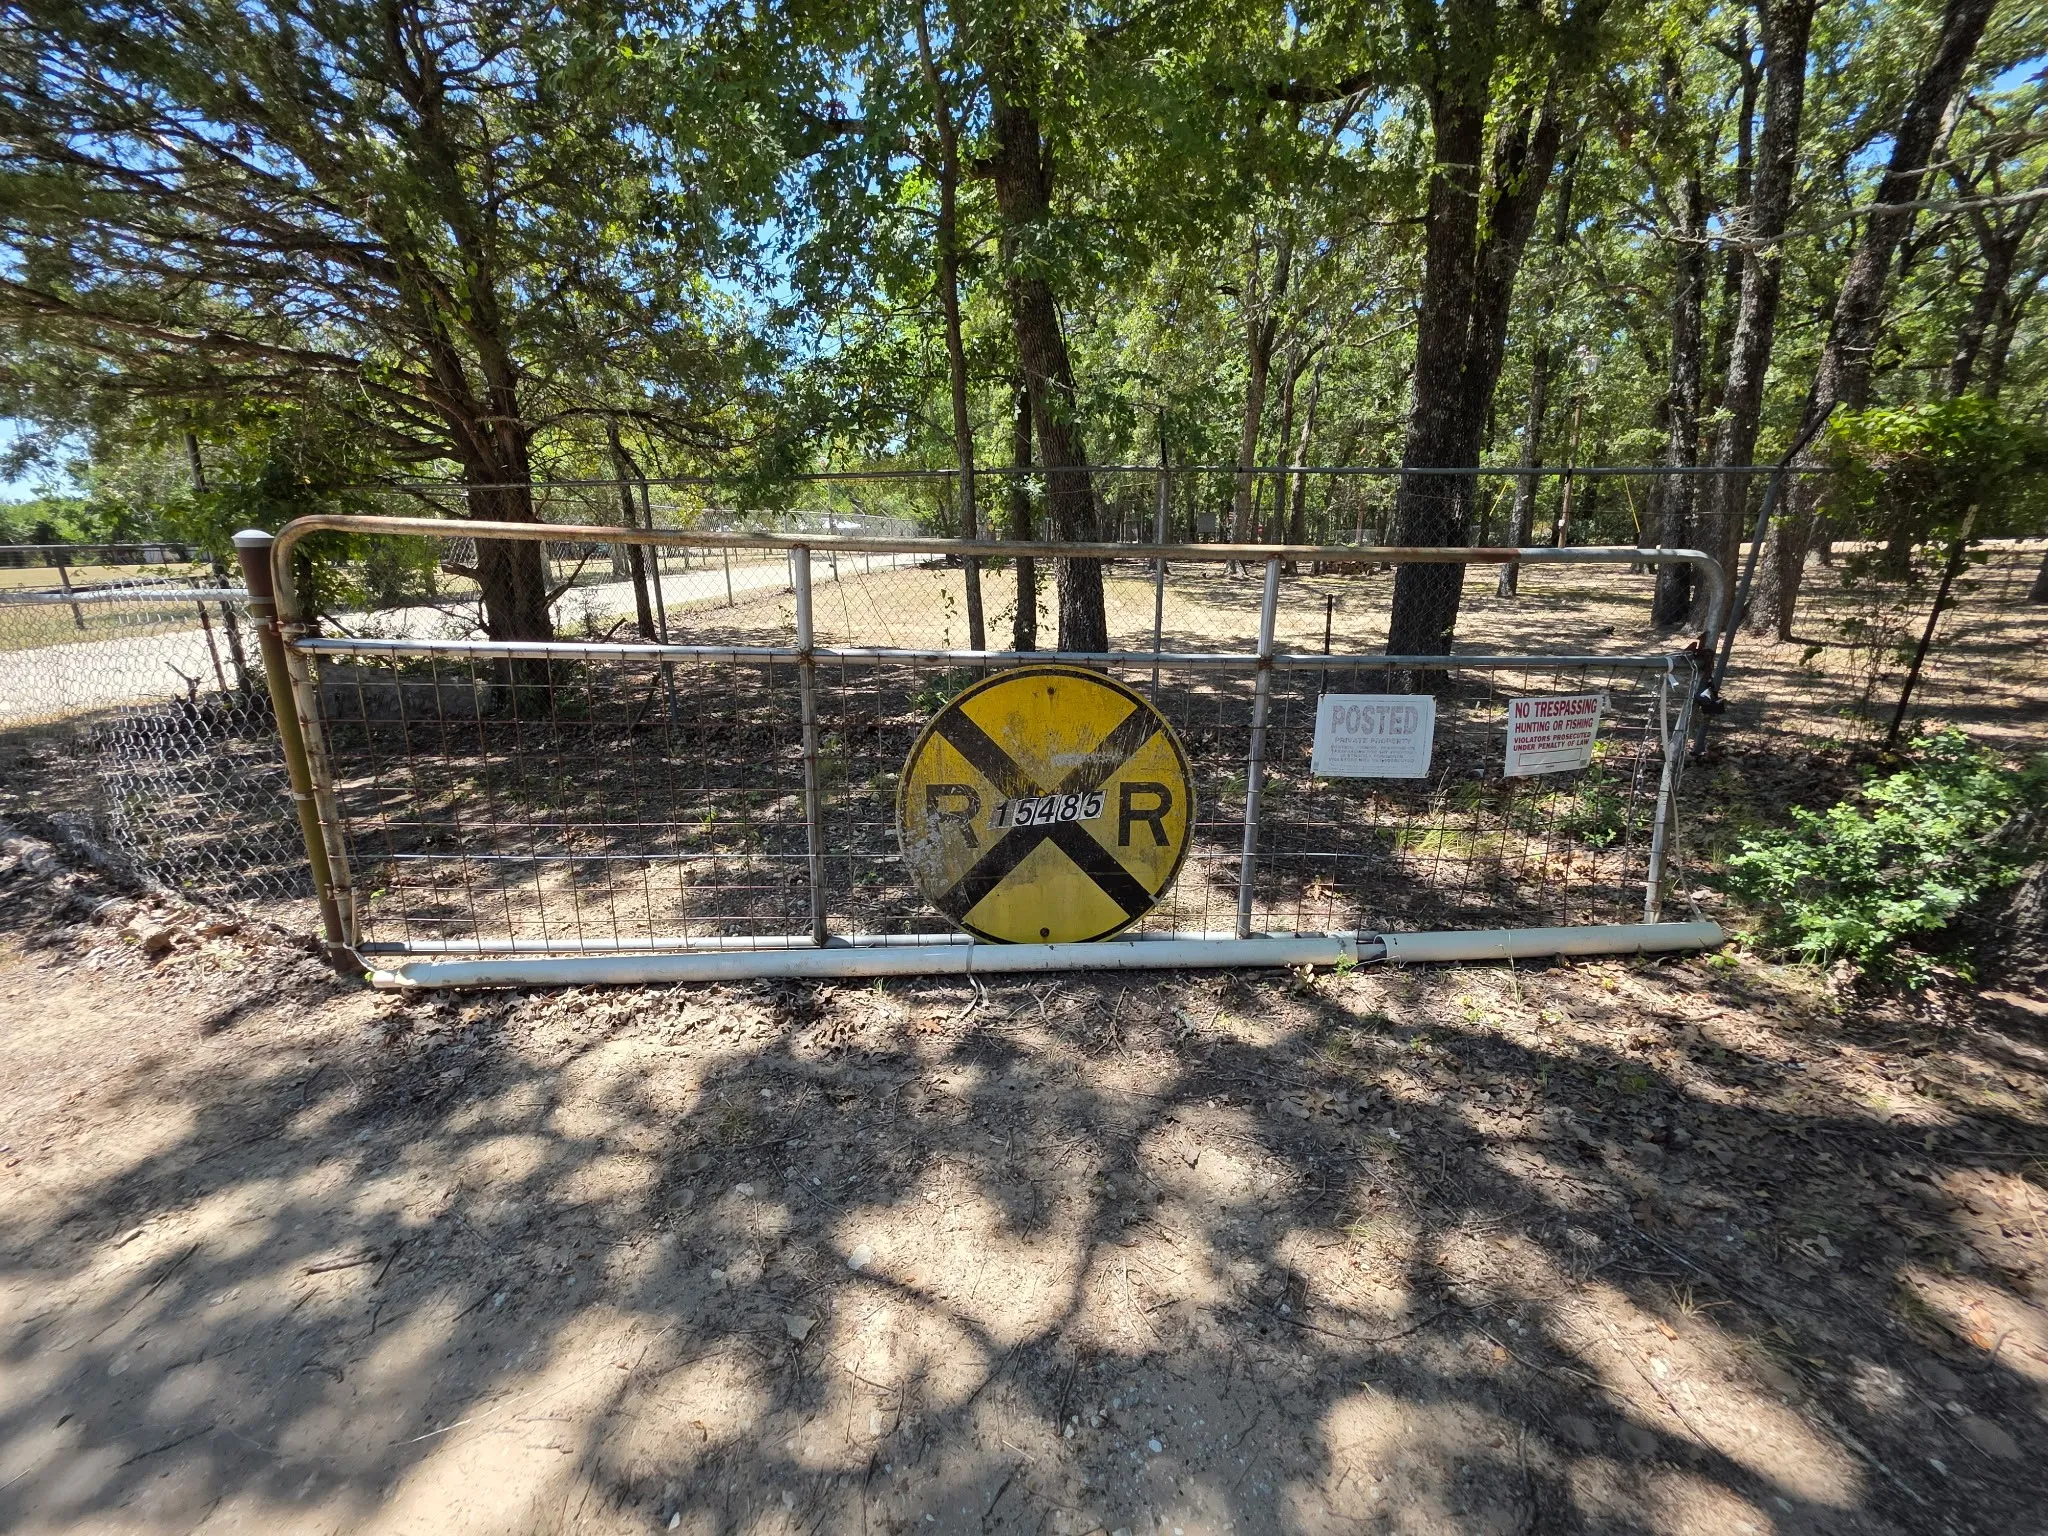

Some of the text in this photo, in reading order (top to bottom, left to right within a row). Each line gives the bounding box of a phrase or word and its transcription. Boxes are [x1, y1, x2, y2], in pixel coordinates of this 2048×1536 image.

[1515, 698, 1598, 719] NO TRESPASSING
[1331, 704, 1419, 735] POSTED
[1515, 717, 1594, 733] HUNTING OR FISHING
[1513, 732, 1592, 744] VIOLATORS PROSECUTED
[1513, 743, 1536, 751] UNDER
[1538, 742, 1565, 750] PENALTY
[925, 781, 1173, 849] R R
[996, 792, 1105, 828] 15485
